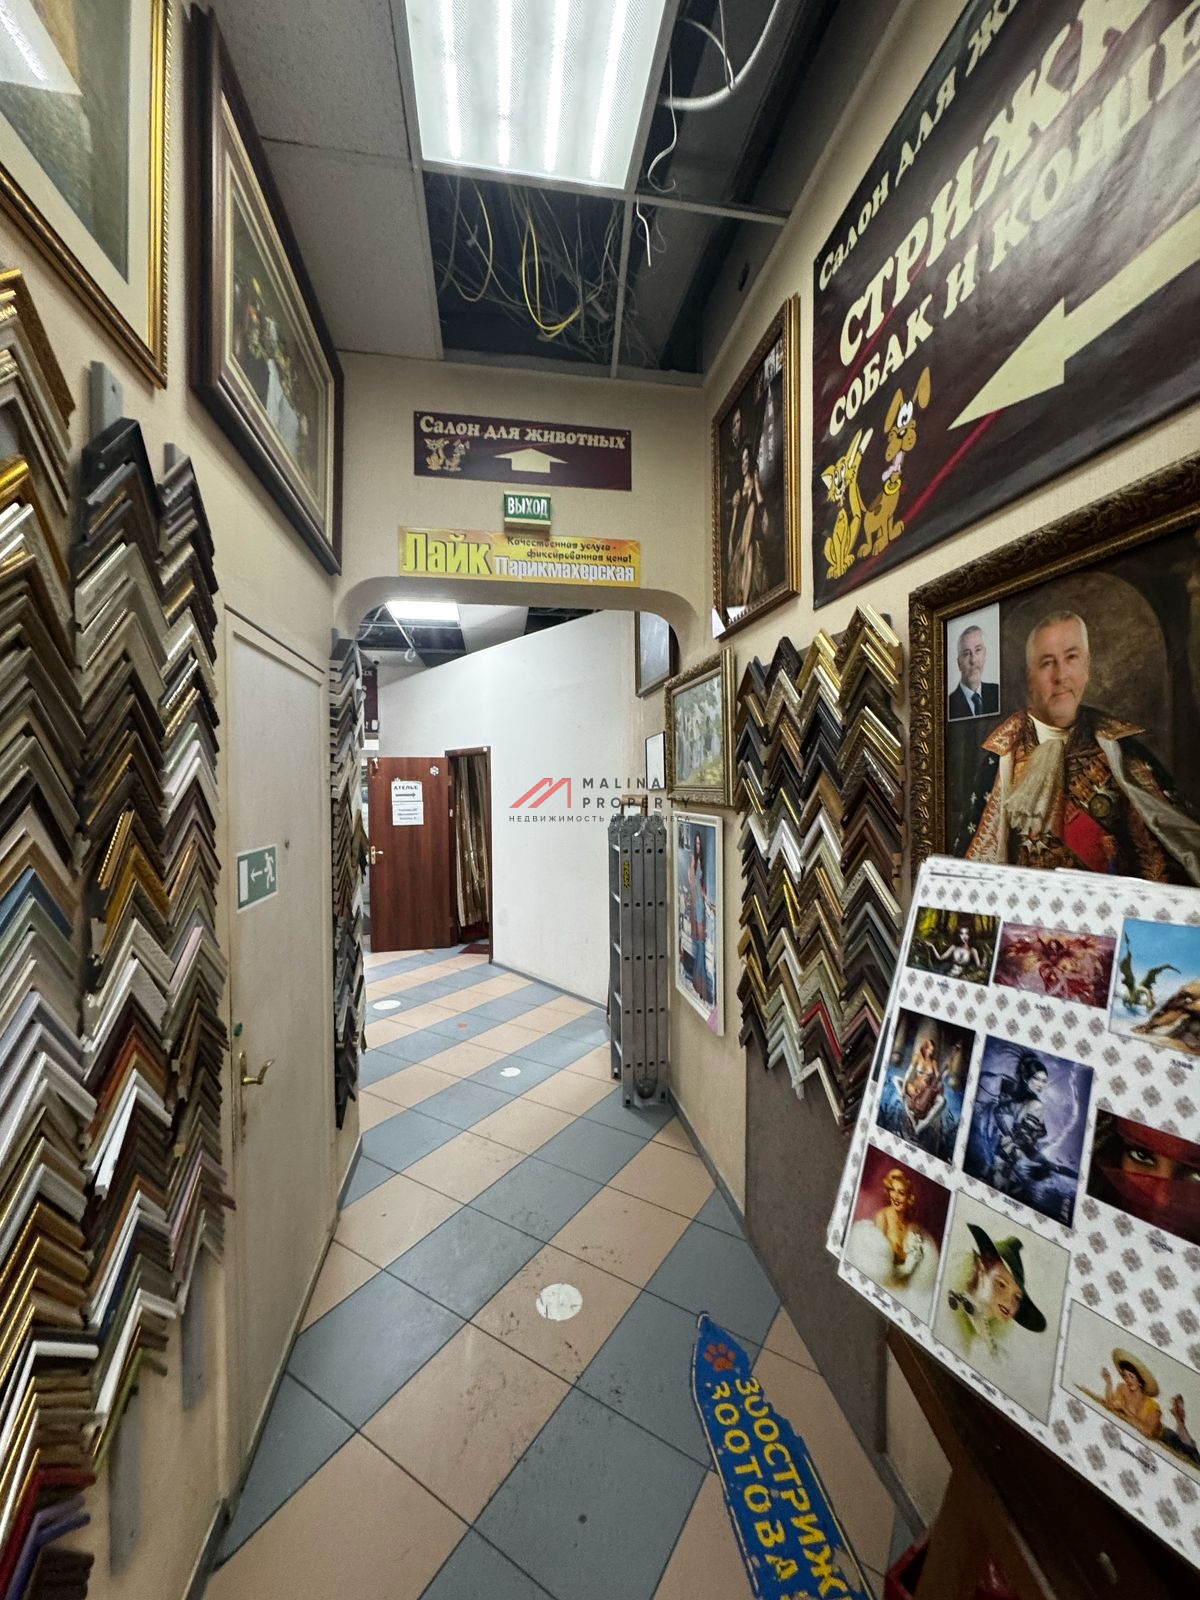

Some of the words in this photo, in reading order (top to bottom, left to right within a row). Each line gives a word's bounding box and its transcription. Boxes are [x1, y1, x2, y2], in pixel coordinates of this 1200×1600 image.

[829, 293, 934, 437] СОБАК
[942, 242, 978, 320] И
[507, 496, 548, 519] ВЫХОД
[402, 532, 492, 575] Лайк
[507, 535, 578, 549] Качественная
[580, 543, 611, 552] услуга
[526, 549, 604, 561] фиксированная
[606, 554, 632, 563] цена!
[494, 555, 636, 582] Парикмахерская
[711, 1381, 809, 1600] ЗООТОВА
[735, 1376, 852, 1600] ЗООСТРИЖ
